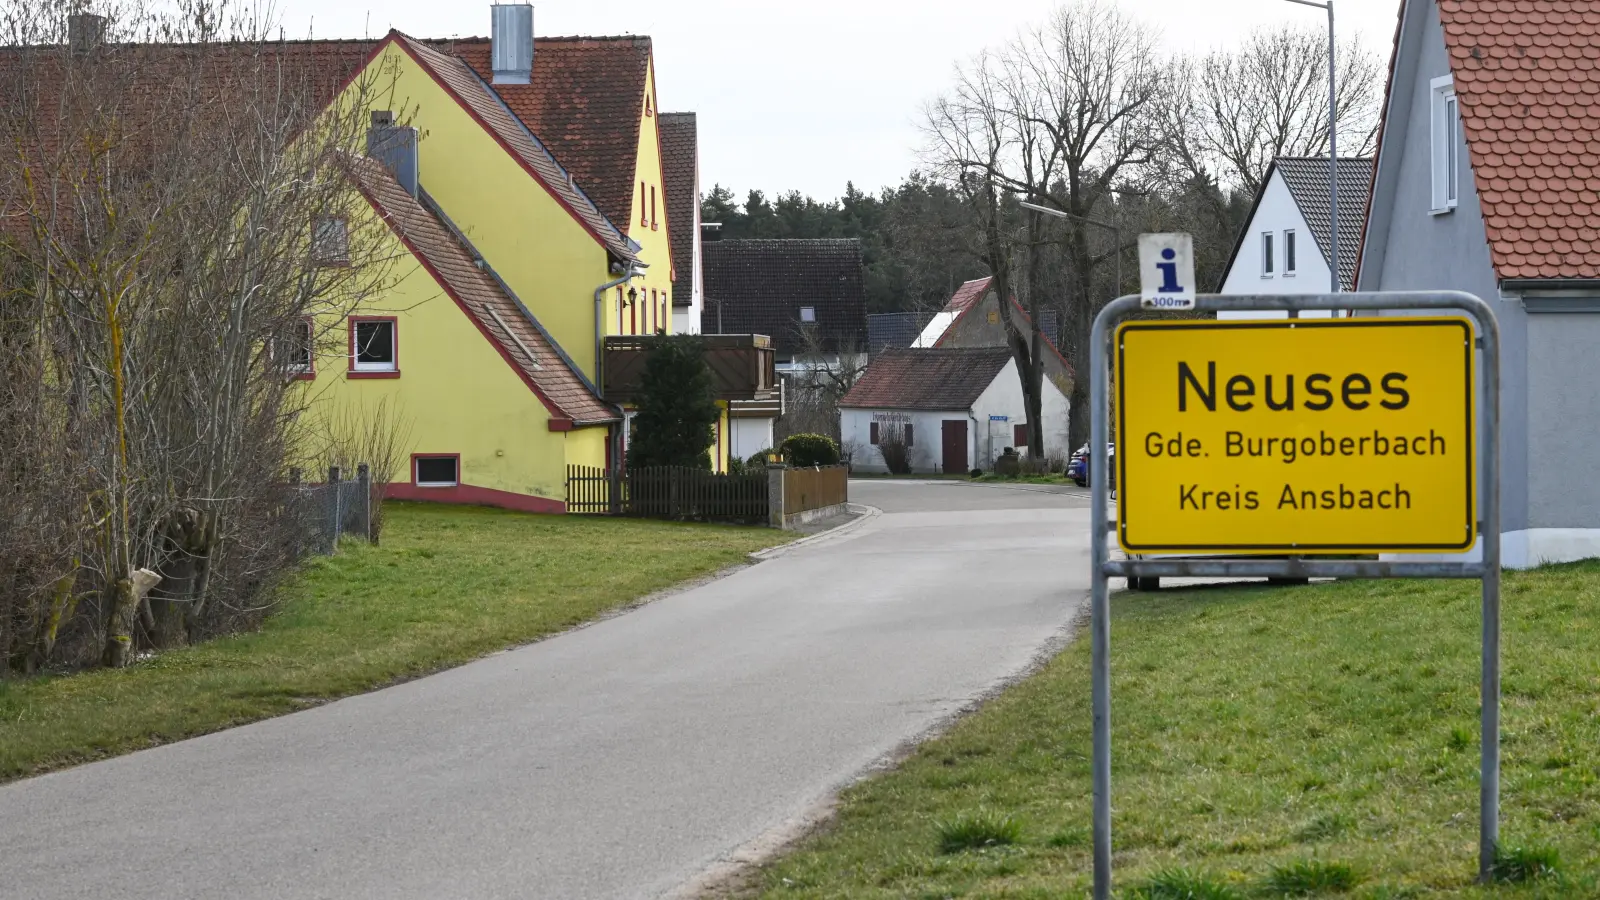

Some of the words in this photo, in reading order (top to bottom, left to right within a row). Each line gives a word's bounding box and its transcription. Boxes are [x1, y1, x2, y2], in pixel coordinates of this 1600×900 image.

[1152, 297, 1188, 307] 300m
[1177, 360, 1410, 413] Neuses
[1144, 431, 1209, 458] Gde.
[1225, 428, 1446, 465] Burgoberbach
[1179, 483, 1260, 510] Kreis
[1277, 482, 1411, 510] Ansbach
